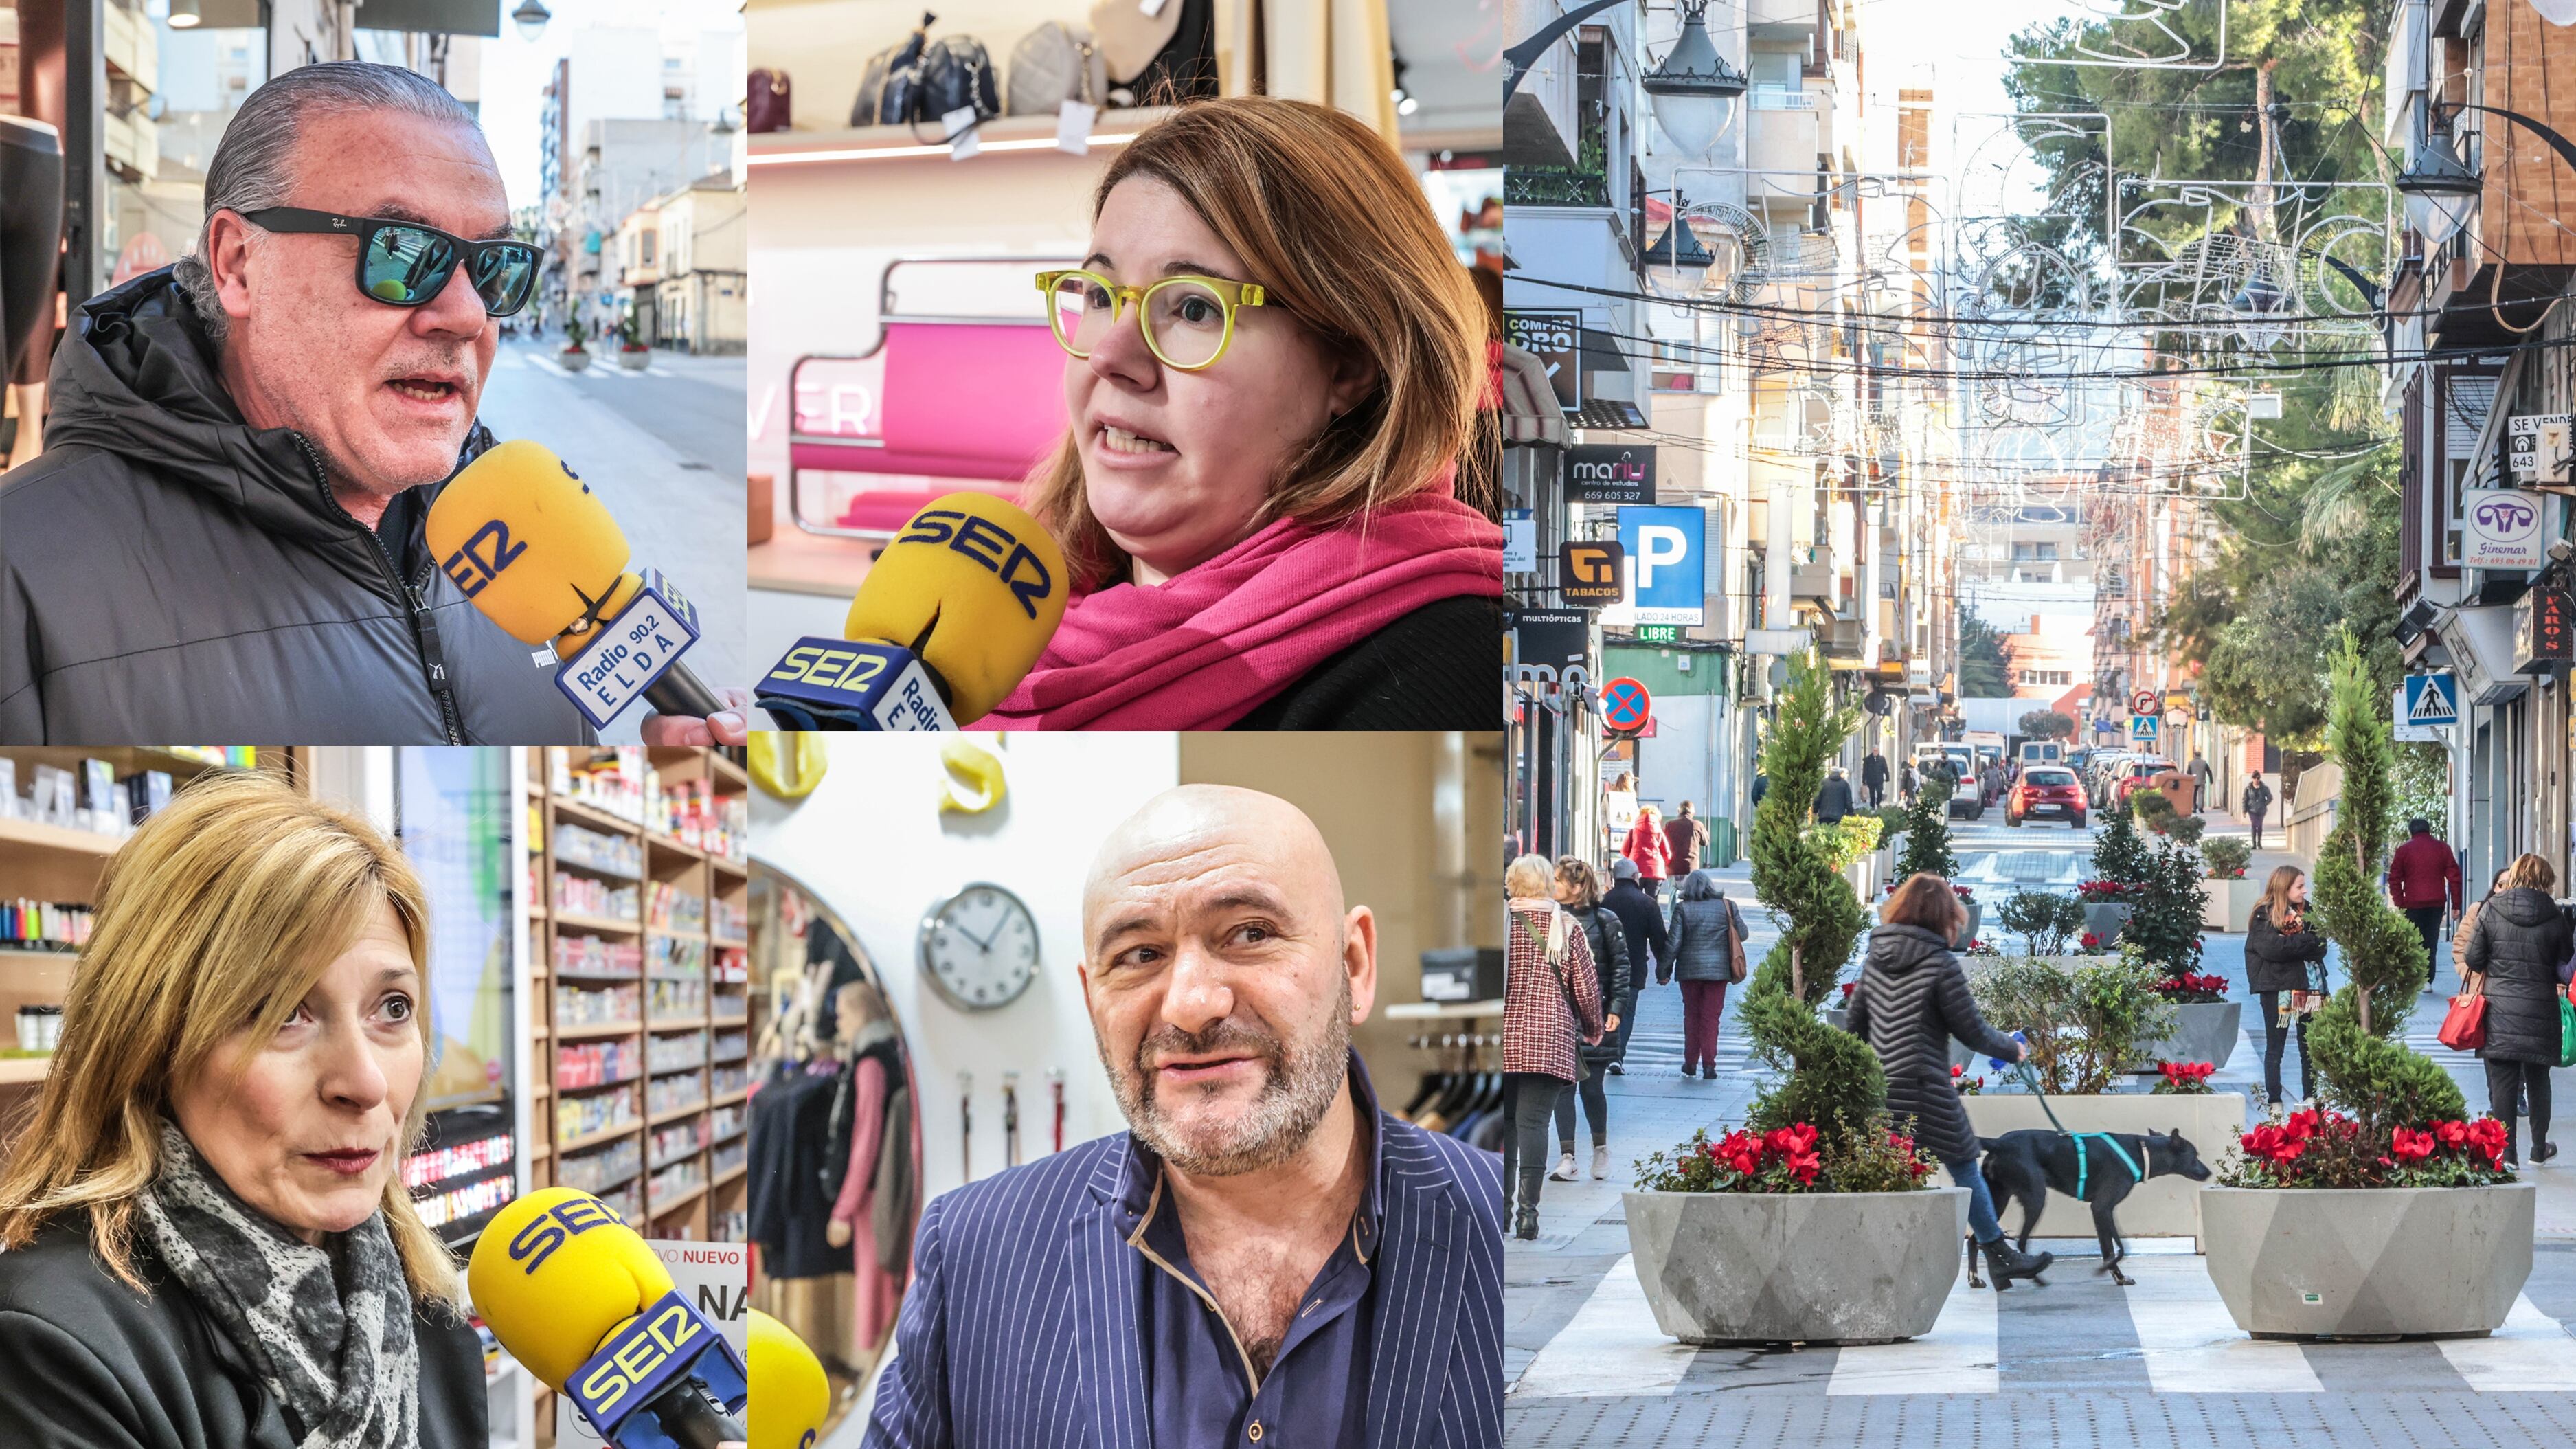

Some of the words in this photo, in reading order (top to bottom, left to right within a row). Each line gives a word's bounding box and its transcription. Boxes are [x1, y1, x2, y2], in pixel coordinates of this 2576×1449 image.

[1509, 319, 1572, 330] COMPRO
[1509, 332, 1571, 352] ORO
[2514, 419, 2529, 431] SE
[2513, 456, 2534, 467] 643
[1585, 491, 1602, 499] 669
[1605, 491, 1621, 500] 605
[1623, 492, 1641, 500] 327
[2478, 542, 2527, 555] Ginemar
[1638, 525, 1687, 589] P
[898, 510, 1051, 620] SER
[1565, 588, 1619, 596] TABACOS
[1660, 614, 1669, 622] 24
[1671, 614, 1699, 622] HORAS
[1640, 627, 1675, 640] LIBRE
[577, 644, 628, 692] Radio
[629, 615, 659, 644] 90.2
[770, 647, 887, 693] SER
[683, 1250, 739, 1265] NUEVO
[583, 1305, 702, 1415] SER
